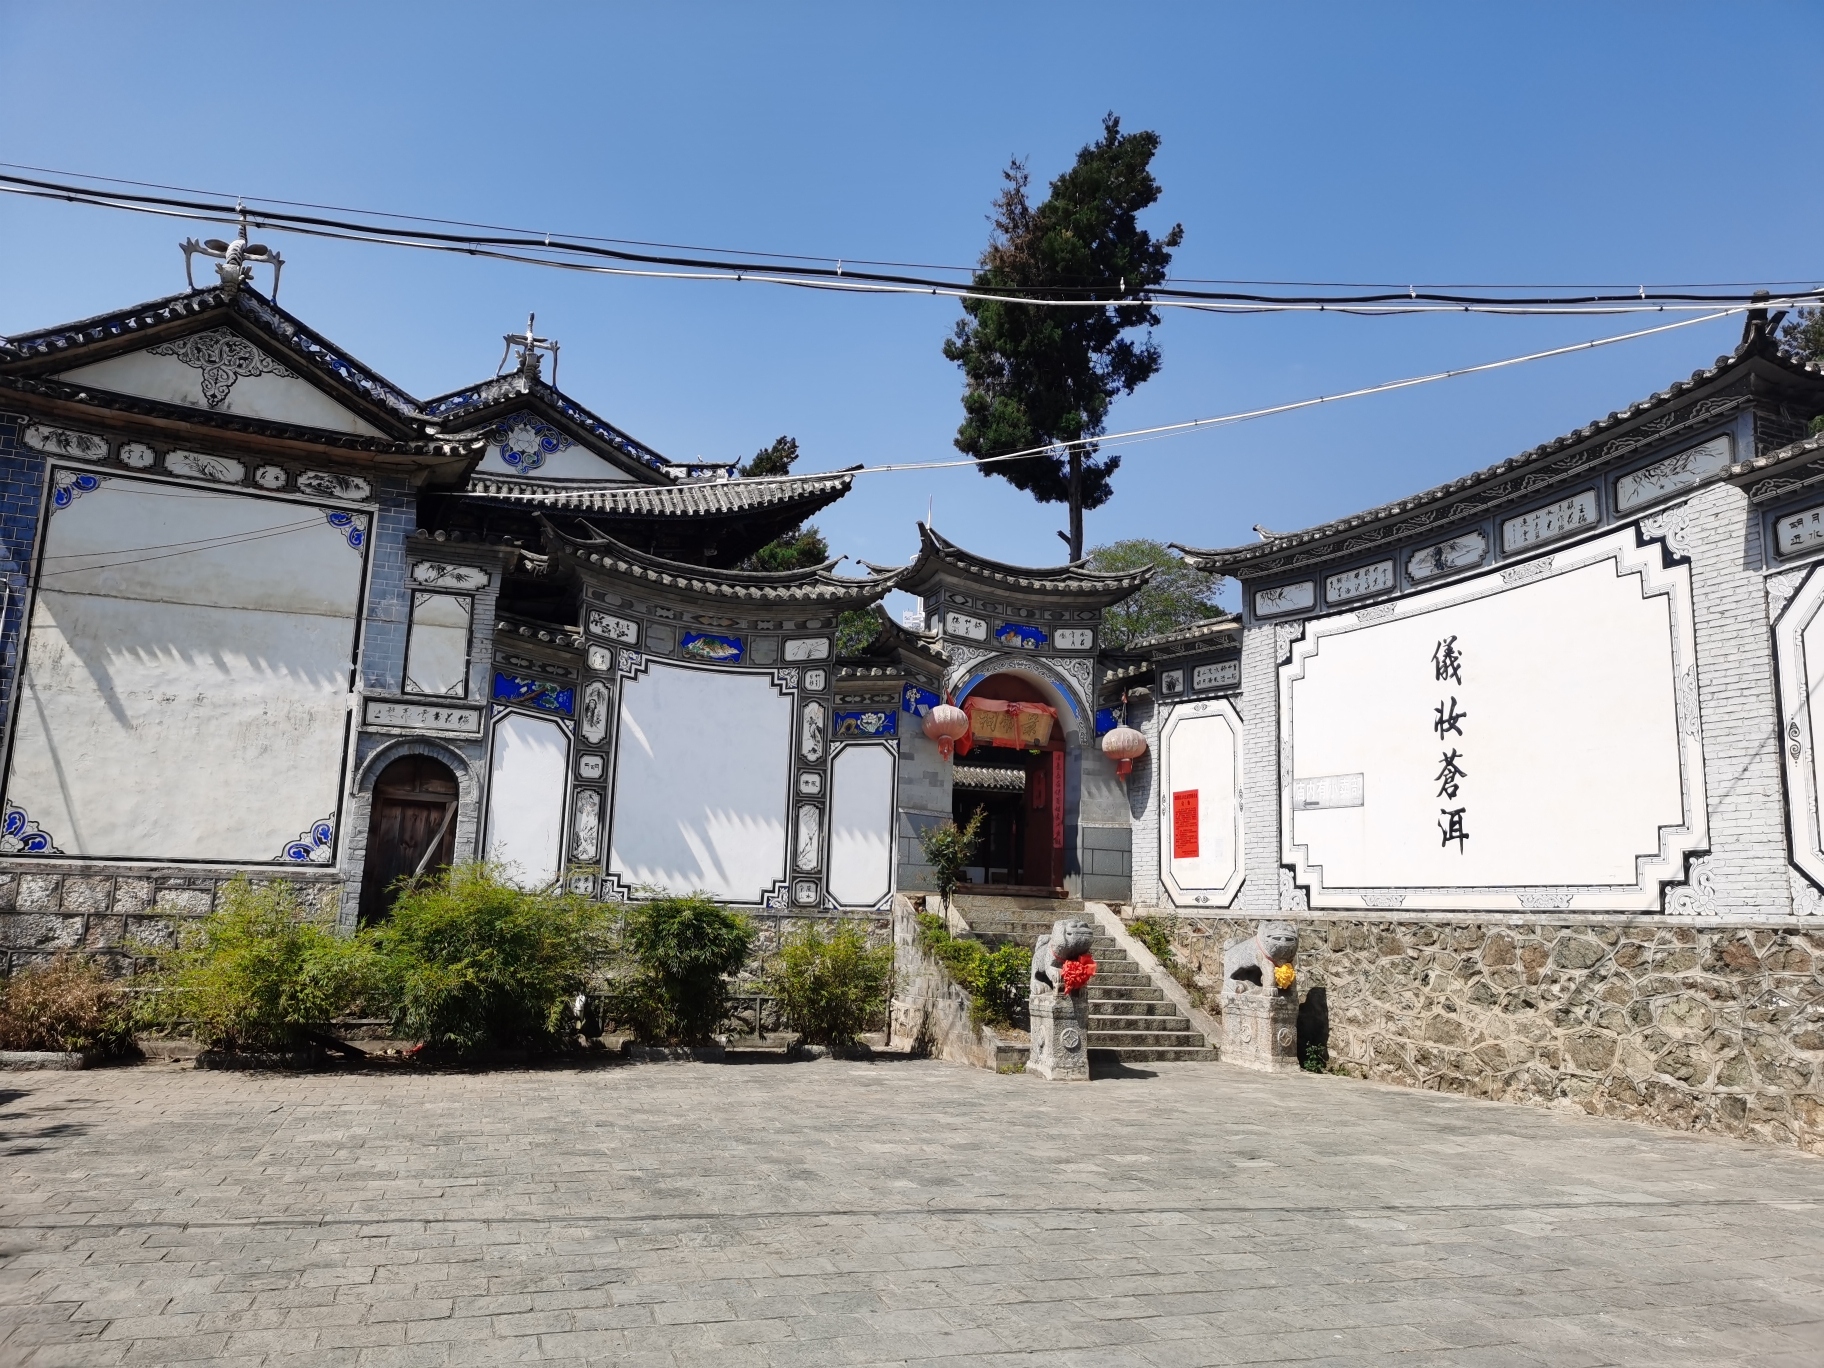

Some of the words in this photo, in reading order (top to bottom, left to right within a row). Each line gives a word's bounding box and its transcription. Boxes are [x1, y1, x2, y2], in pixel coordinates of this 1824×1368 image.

[1295, 776, 1362, 801] 庙内有小卖部
